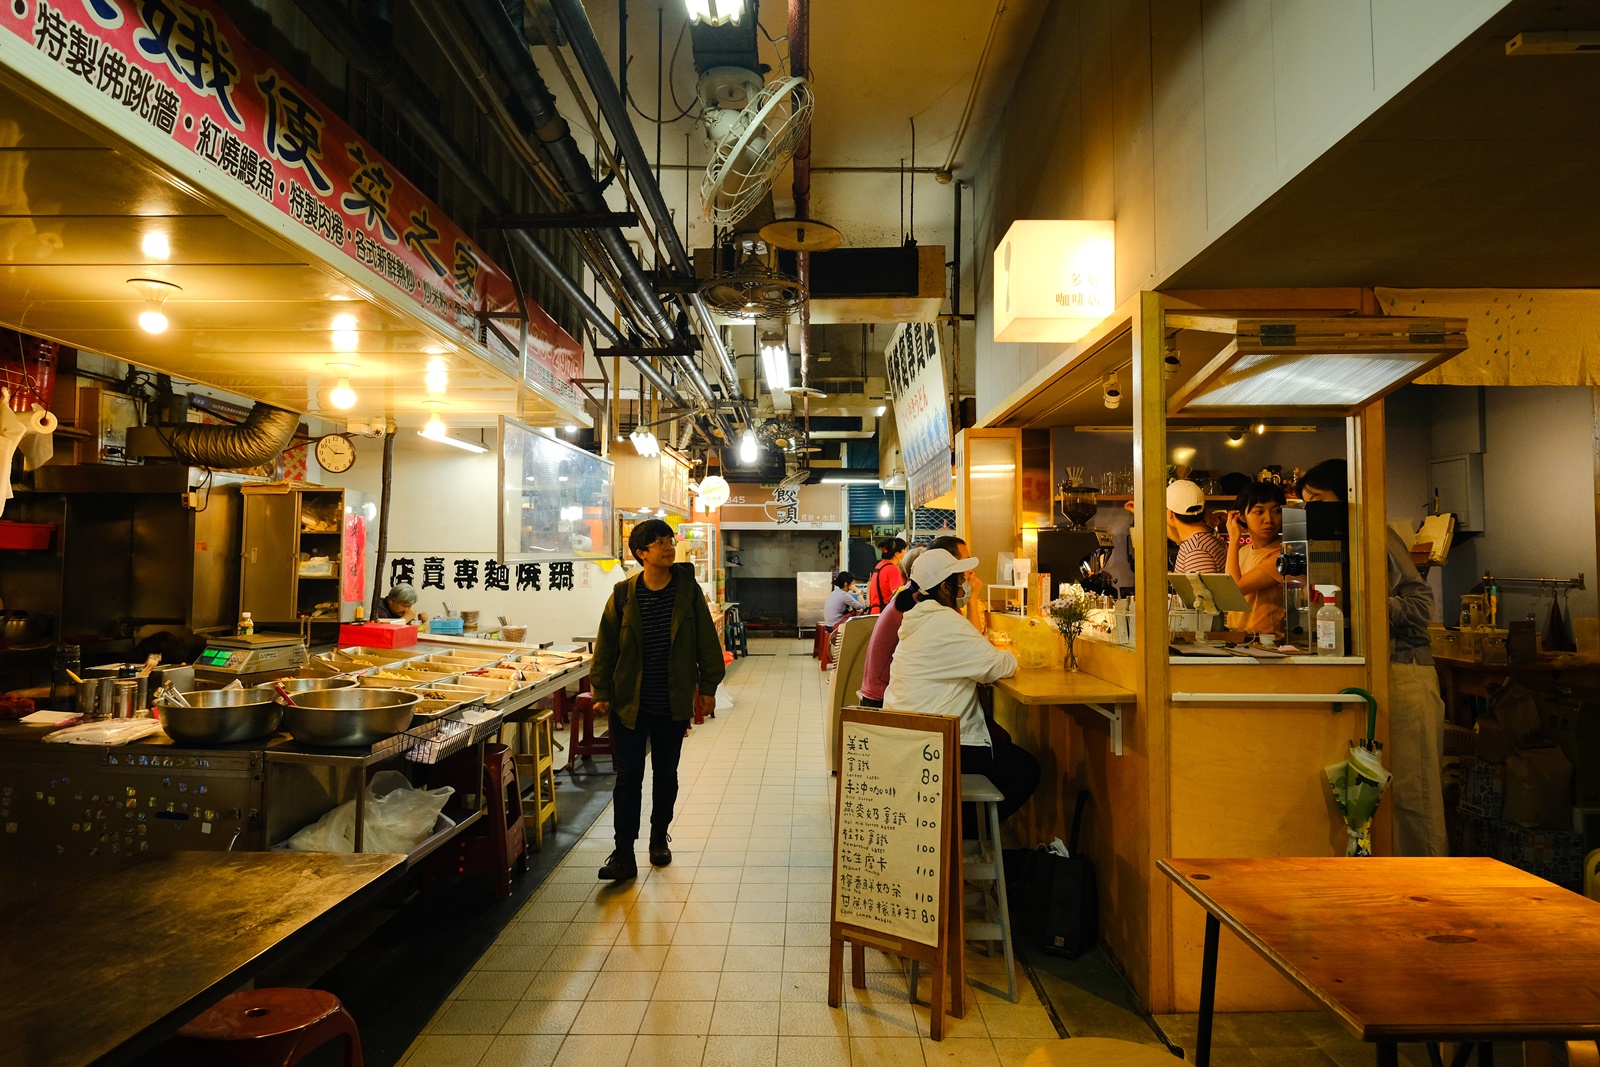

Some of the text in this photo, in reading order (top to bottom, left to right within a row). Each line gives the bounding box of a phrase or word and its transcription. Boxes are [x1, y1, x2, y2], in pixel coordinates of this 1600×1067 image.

[90, 0, 478, 300] 娥便菜之家
[194, 116, 274, 200] 紅燒鰻魚
[355, 230, 415, 292] 各式新鮮熱炒
[847, 736, 940, 761] 美式 60
[847, 757, 939, 784] 拿鐵 80
[844, 802, 936, 828] 燕麥奶拿鐵 100
[842, 828, 935, 853] 桂花拿鐵 100
[841, 849, 935, 877] 花生摩卡 110
[841, 893, 936, 923] 甘蔗檸檬蘇打 80
[916, 892, 933, 903] 110
